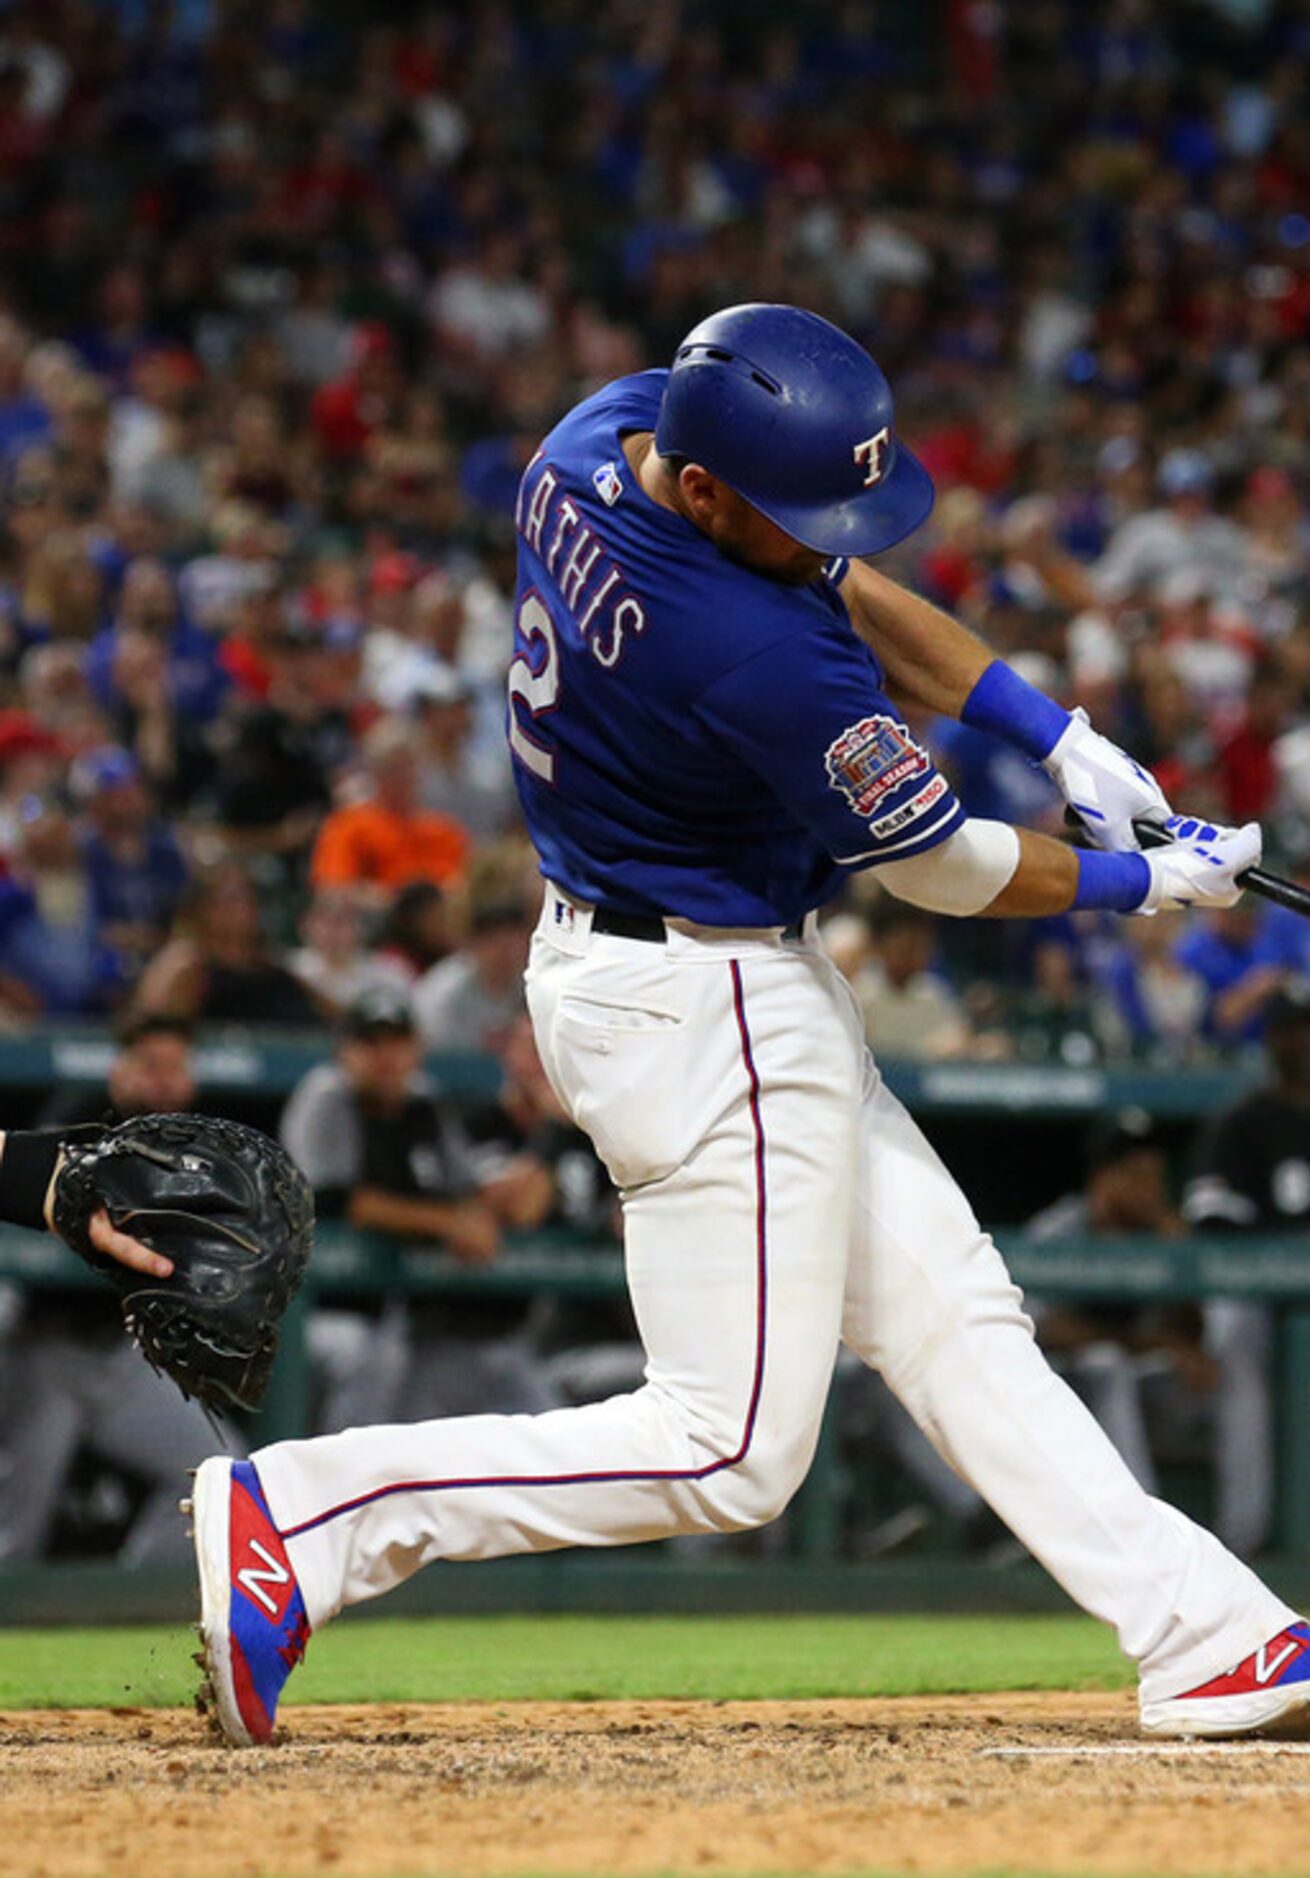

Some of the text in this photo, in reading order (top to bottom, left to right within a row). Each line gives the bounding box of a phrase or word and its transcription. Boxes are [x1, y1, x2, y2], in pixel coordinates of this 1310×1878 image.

[852, 425, 891, 487] T
[507, 587, 561, 786] 2
[236, 1539, 291, 1616] N
